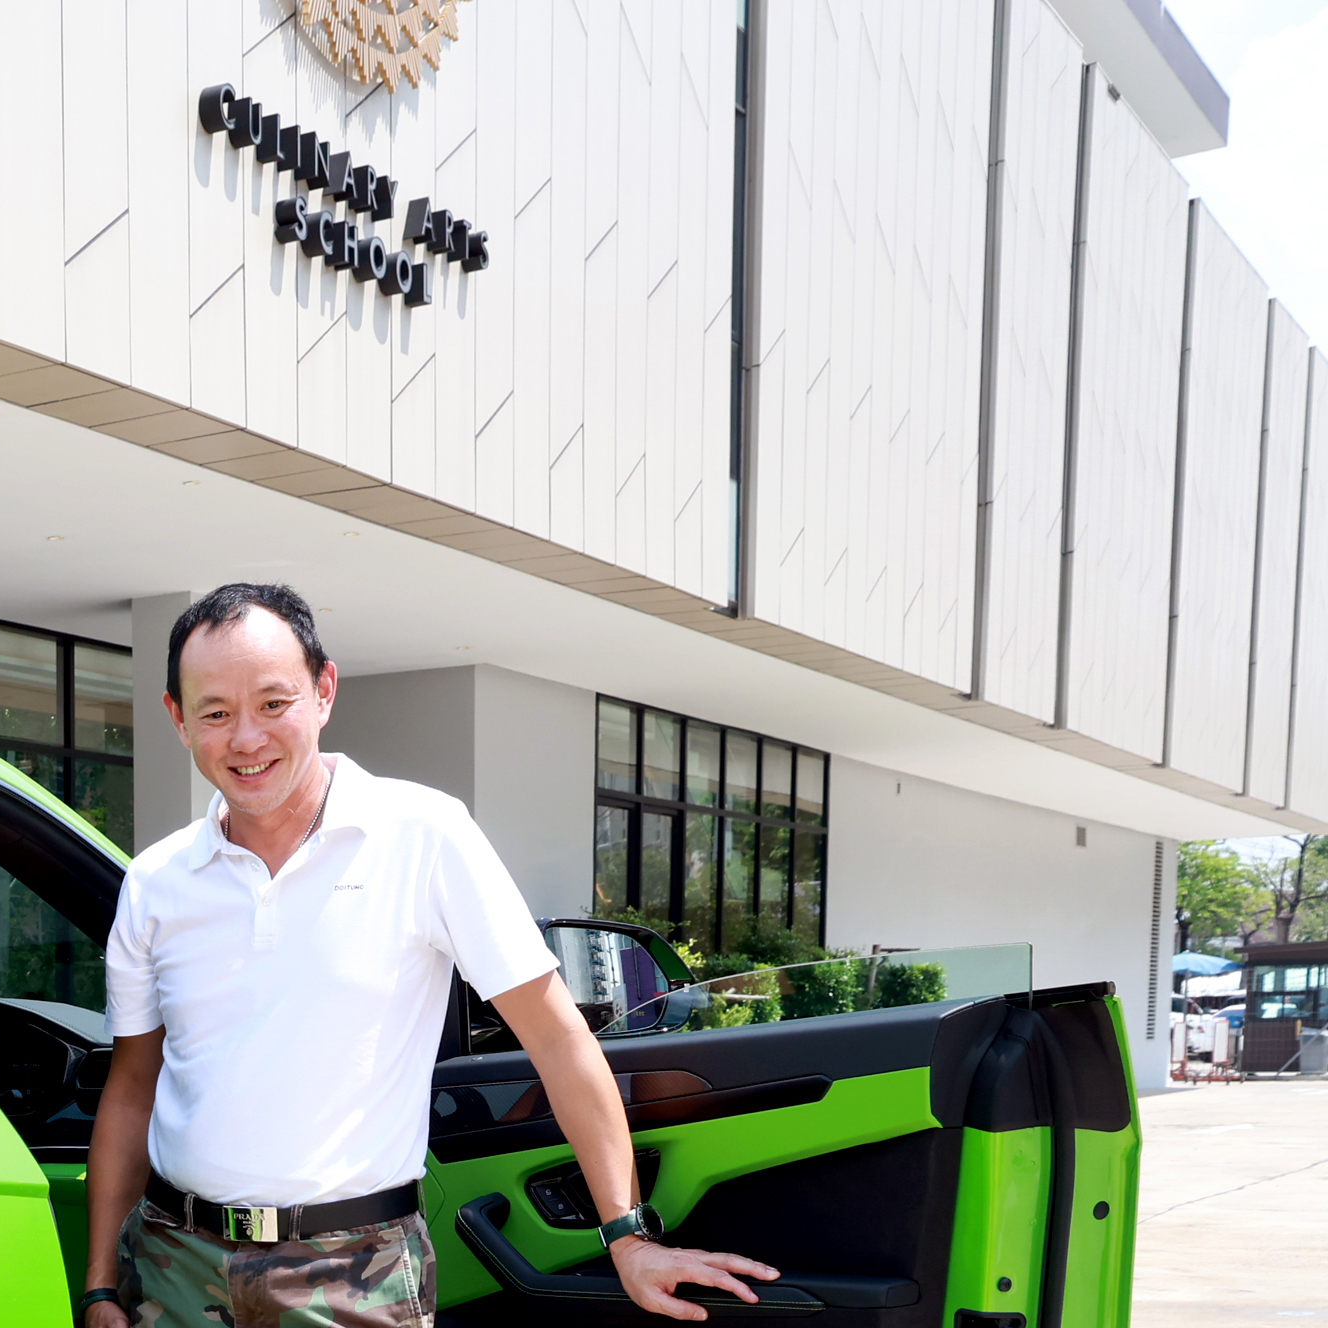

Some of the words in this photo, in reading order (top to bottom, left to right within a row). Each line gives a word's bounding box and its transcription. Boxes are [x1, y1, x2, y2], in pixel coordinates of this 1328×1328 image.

[199, 83, 398, 222] CULINARY
[403, 196, 489, 273] ARTS
[274, 196, 432, 308] SCHOOL
[234, 1213, 265, 1221] PRADA
